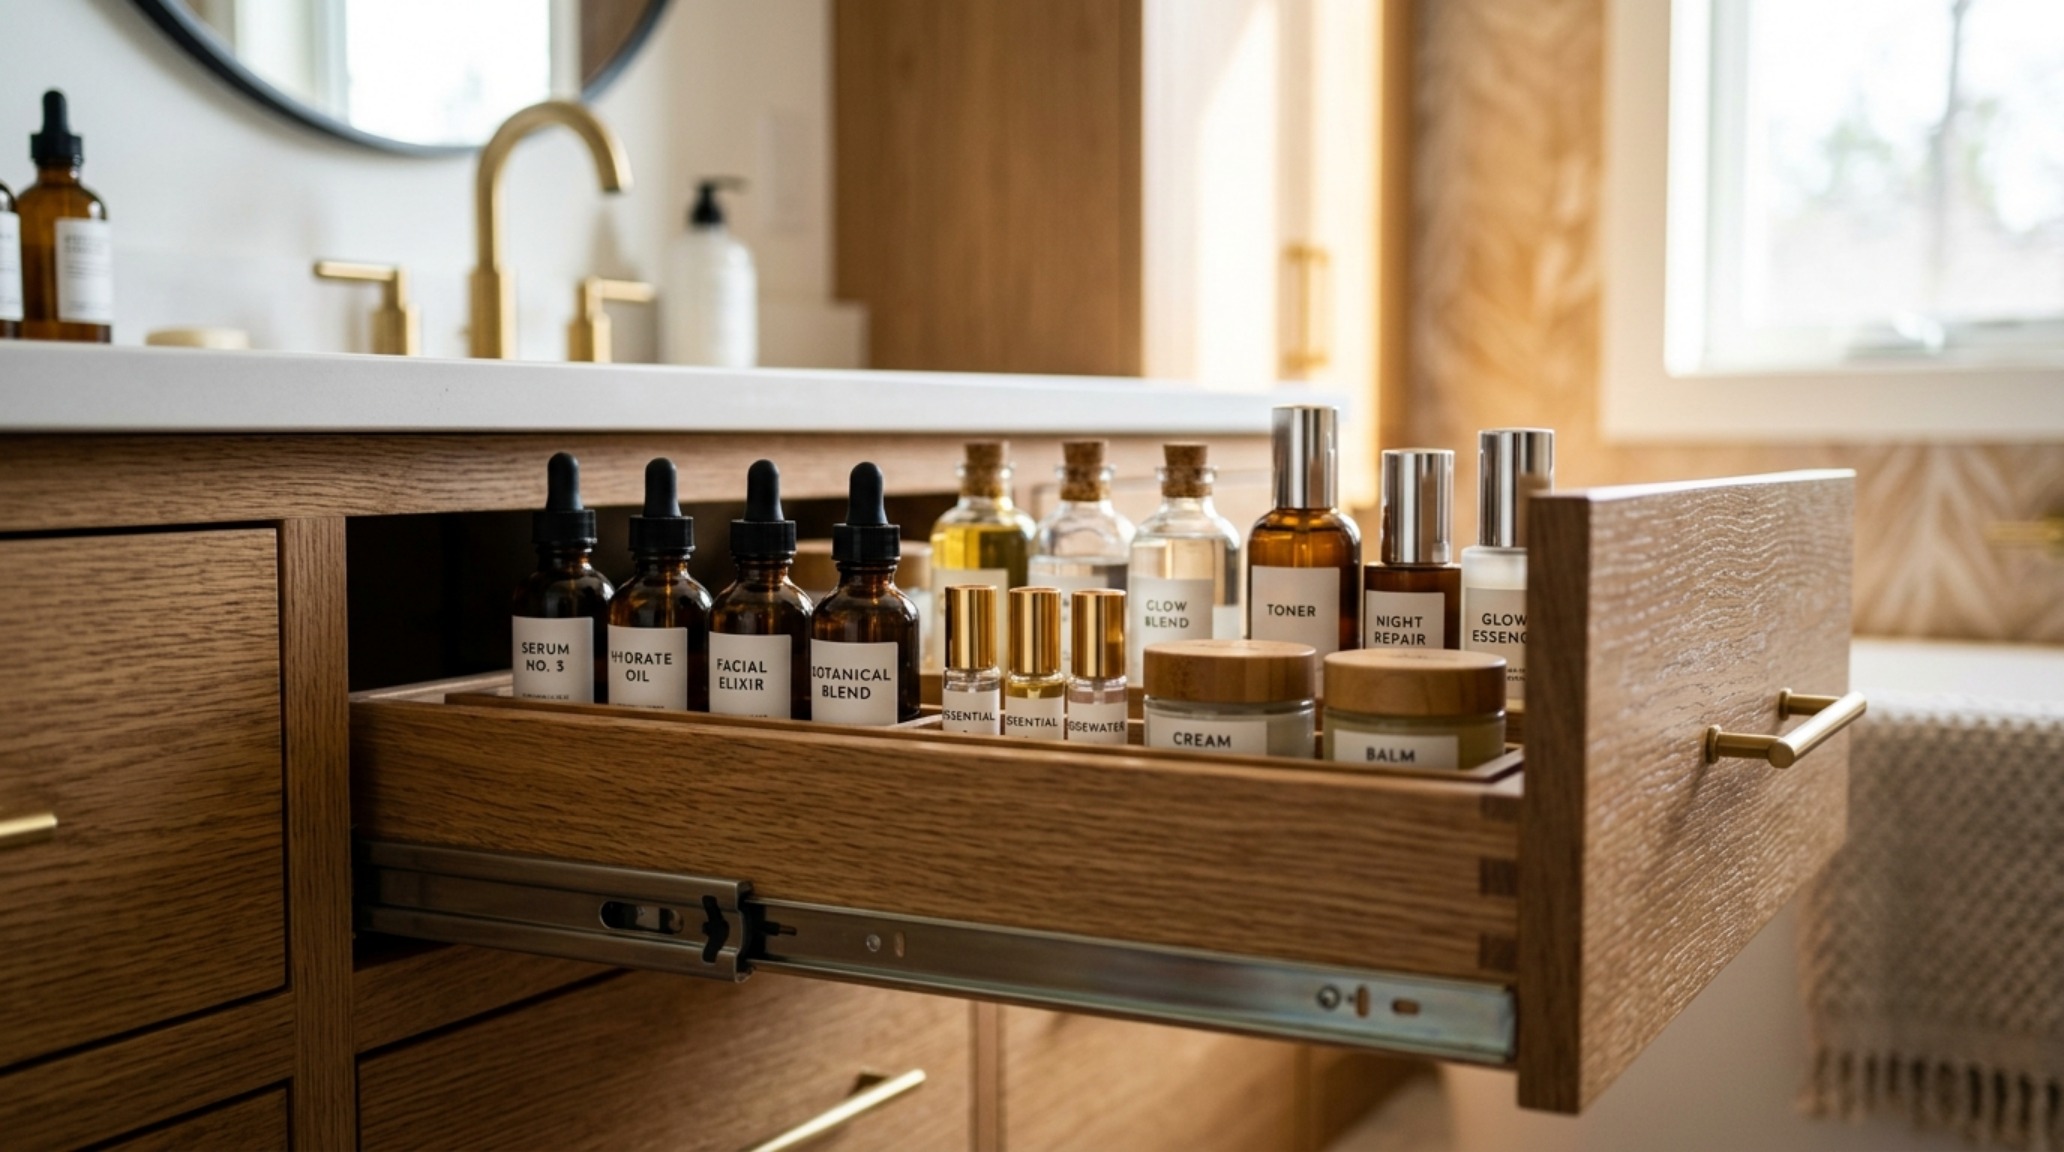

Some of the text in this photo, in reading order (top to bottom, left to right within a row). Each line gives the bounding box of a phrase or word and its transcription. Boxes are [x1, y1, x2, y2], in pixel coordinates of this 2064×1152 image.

[1146, 600, 1187, 612] GLOW
[1267, 604, 1316, 617] TONER
[1145, 616, 1189, 628] BLEND
[1376, 615, 1423, 628] NIGHT
[1482, 613, 1528, 626] GLOW
[1374, 631, 1425, 645] REPAIR
[521, 642, 570, 655] SERUM
[526, 660, 565, 672] NO. 3
[717, 658, 767, 673] FACIAL
[625, 669, 650, 683] OIL
[719, 677, 764, 690] ELIXIR
[822, 685, 871, 700] BLEND
[1173, 731, 1231, 748] CREAM
[1366, 747, 1415, 762] BALM
